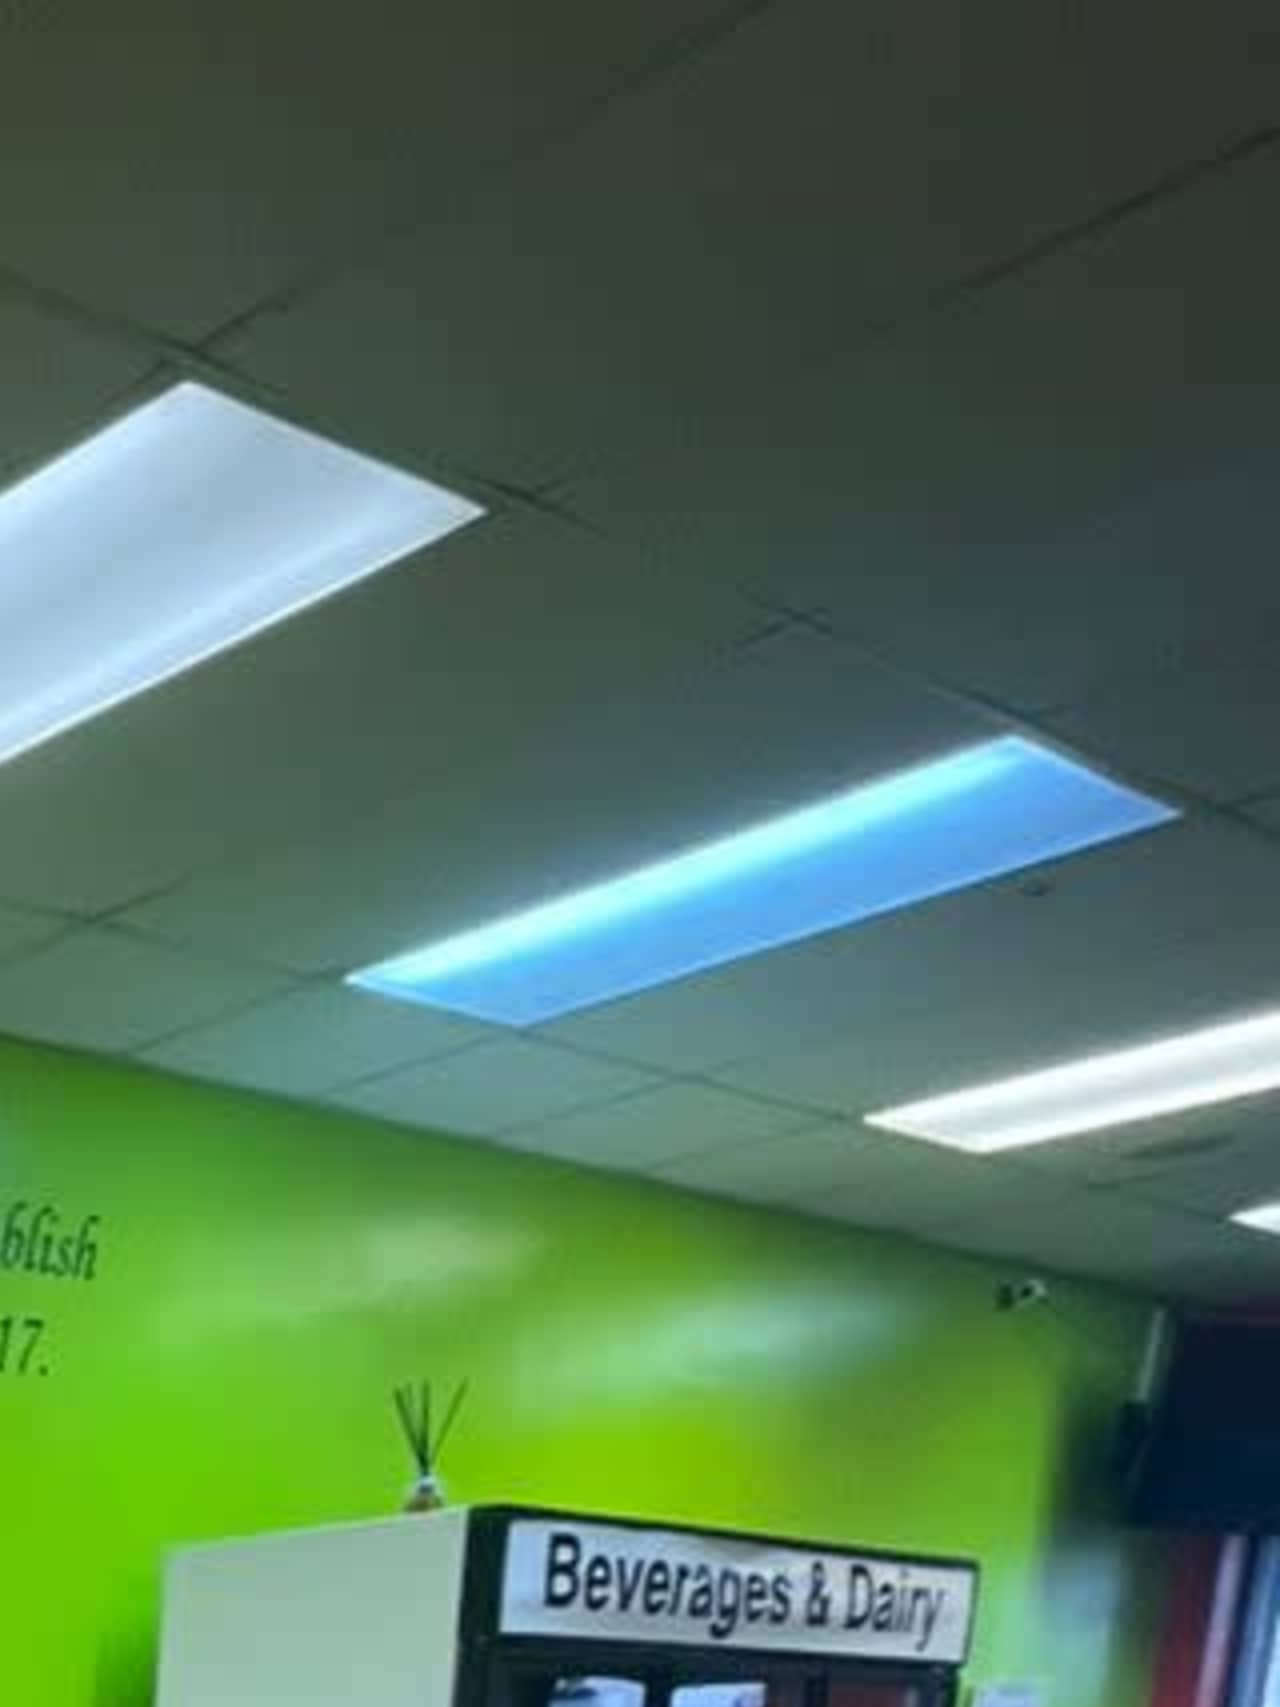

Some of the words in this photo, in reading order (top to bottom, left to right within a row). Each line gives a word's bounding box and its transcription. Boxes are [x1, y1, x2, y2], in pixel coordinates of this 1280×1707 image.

[543, 1532, 792, 1640] Beverages
[805, 1562, 831, 1628] &
[843, 1563, 944, 1653] Dairy
